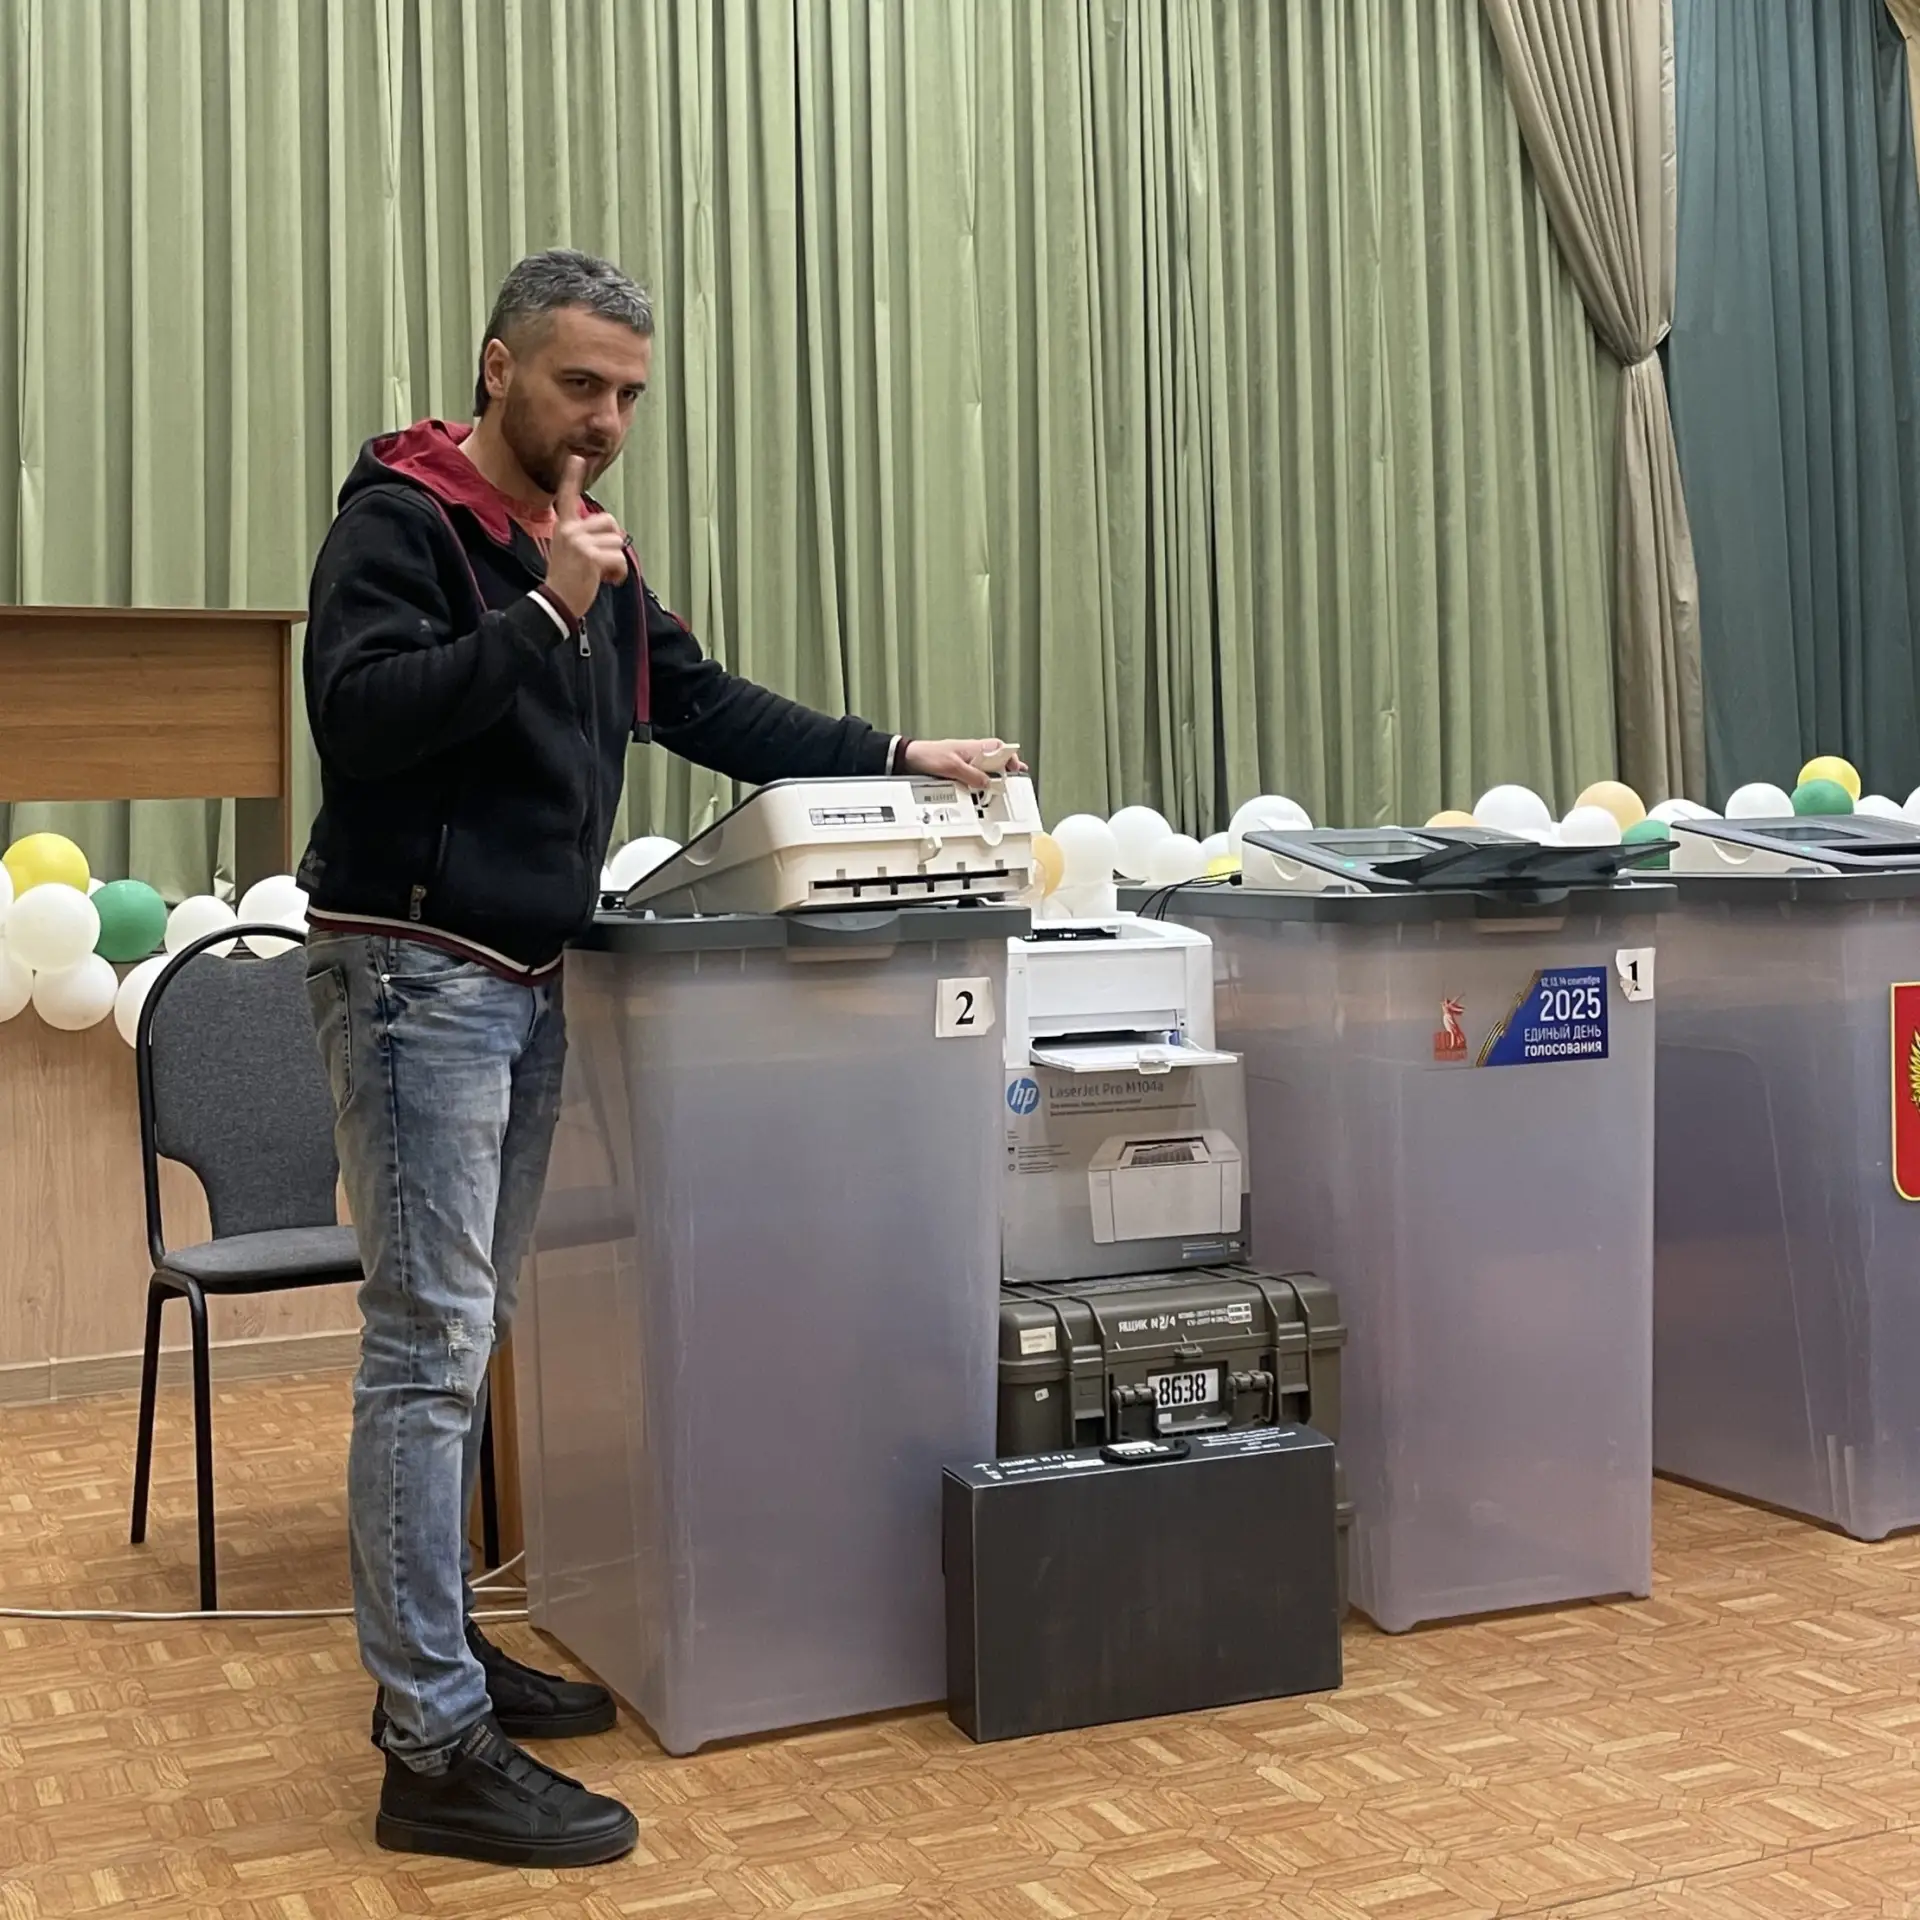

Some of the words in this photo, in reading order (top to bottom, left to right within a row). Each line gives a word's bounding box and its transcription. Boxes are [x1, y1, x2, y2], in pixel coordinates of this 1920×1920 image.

[1627, 960, 1641, 991] 1
[955, 990, 975, 1026] 2
[1540, 987, 1601, 1021] 2025
[1524, 1024, 1570, 1043] ЕДИНЫЙ
[1573, 1024, 1602, 1041] ДЕНЬ
[1524, 1041, 1602, 1057] голосования
[1010, 1079, 1038, 1115] hp
[1050, 1083, 1099, 1099] LaserJet
[1103, 1083, 1123, 1096] Pro
[1126, 1079, 1164, 1094] M104a
[1118, 1319, 1149, 1333] ЯЩИК
[1159, 1373, 1206, 1406] 8638
